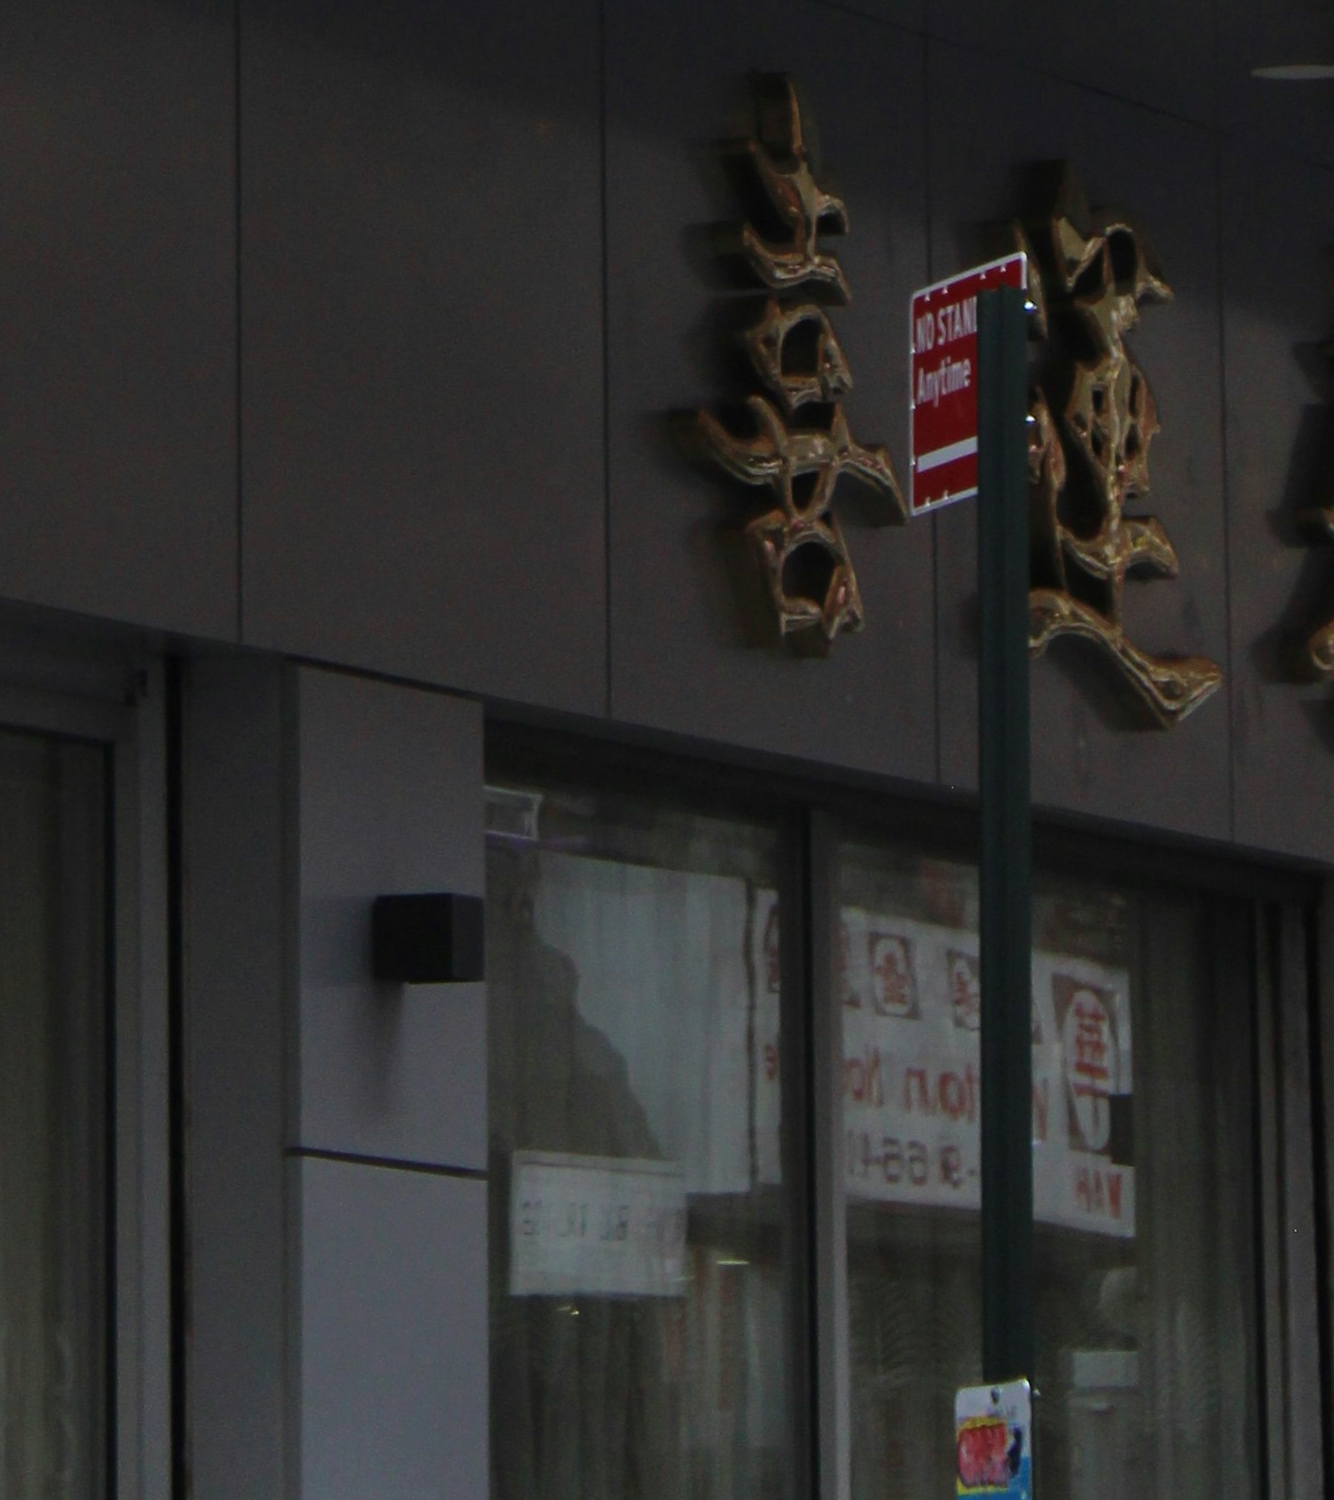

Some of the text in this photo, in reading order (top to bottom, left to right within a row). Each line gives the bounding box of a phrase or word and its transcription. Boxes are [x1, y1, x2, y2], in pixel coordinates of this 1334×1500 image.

[916, 296, 978, 354] NO STAN
[916, 356, 972, 408] Anytime
